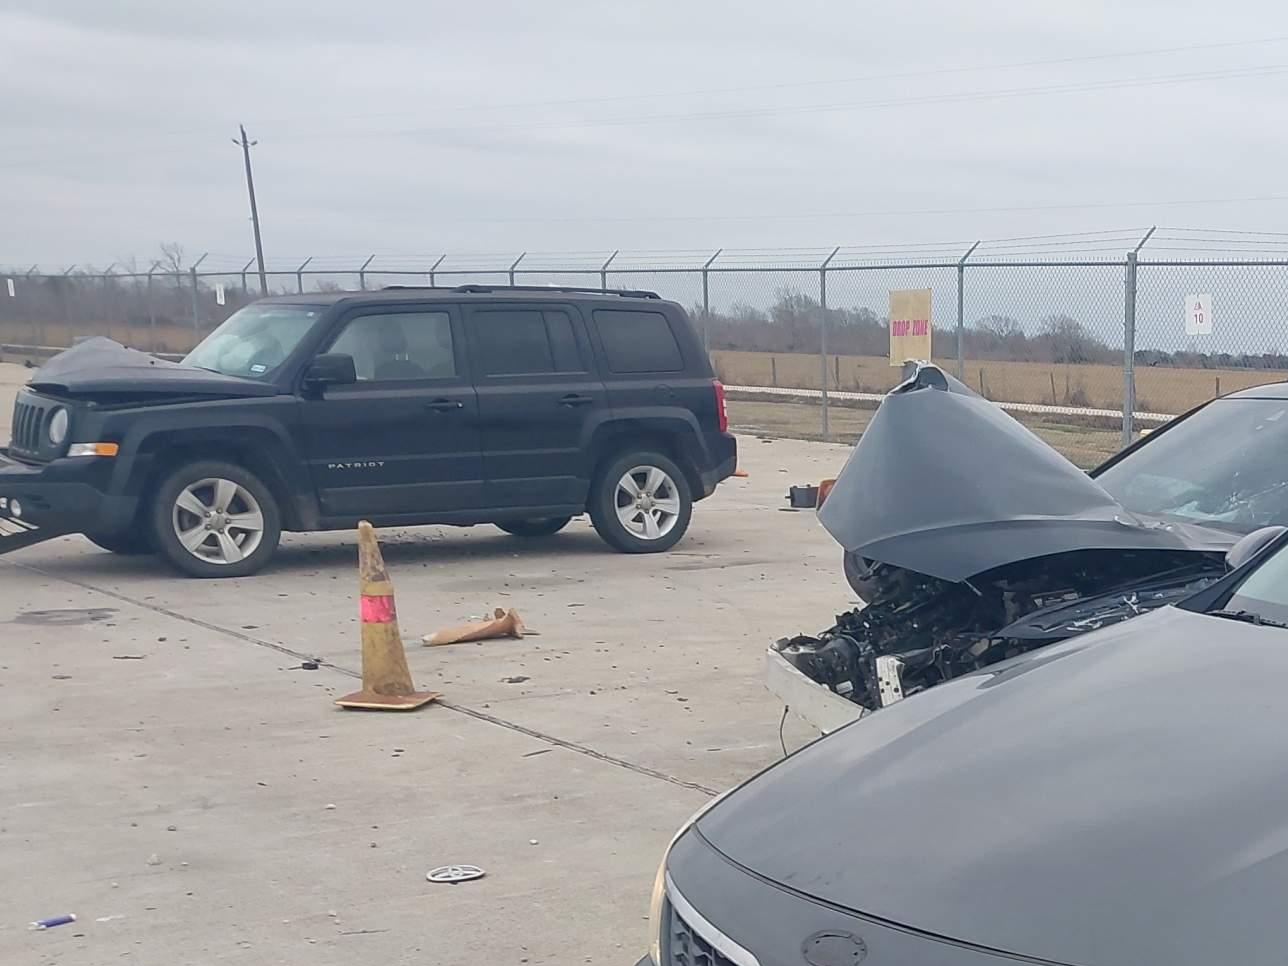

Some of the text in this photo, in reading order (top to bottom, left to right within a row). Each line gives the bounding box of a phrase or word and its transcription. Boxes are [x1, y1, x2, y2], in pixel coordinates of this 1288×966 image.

[1194, 312, 1204, 325] 10
[892, 320, 929, 336] DROP ZONE
[327, 461, 385, 469] PATRIOT
